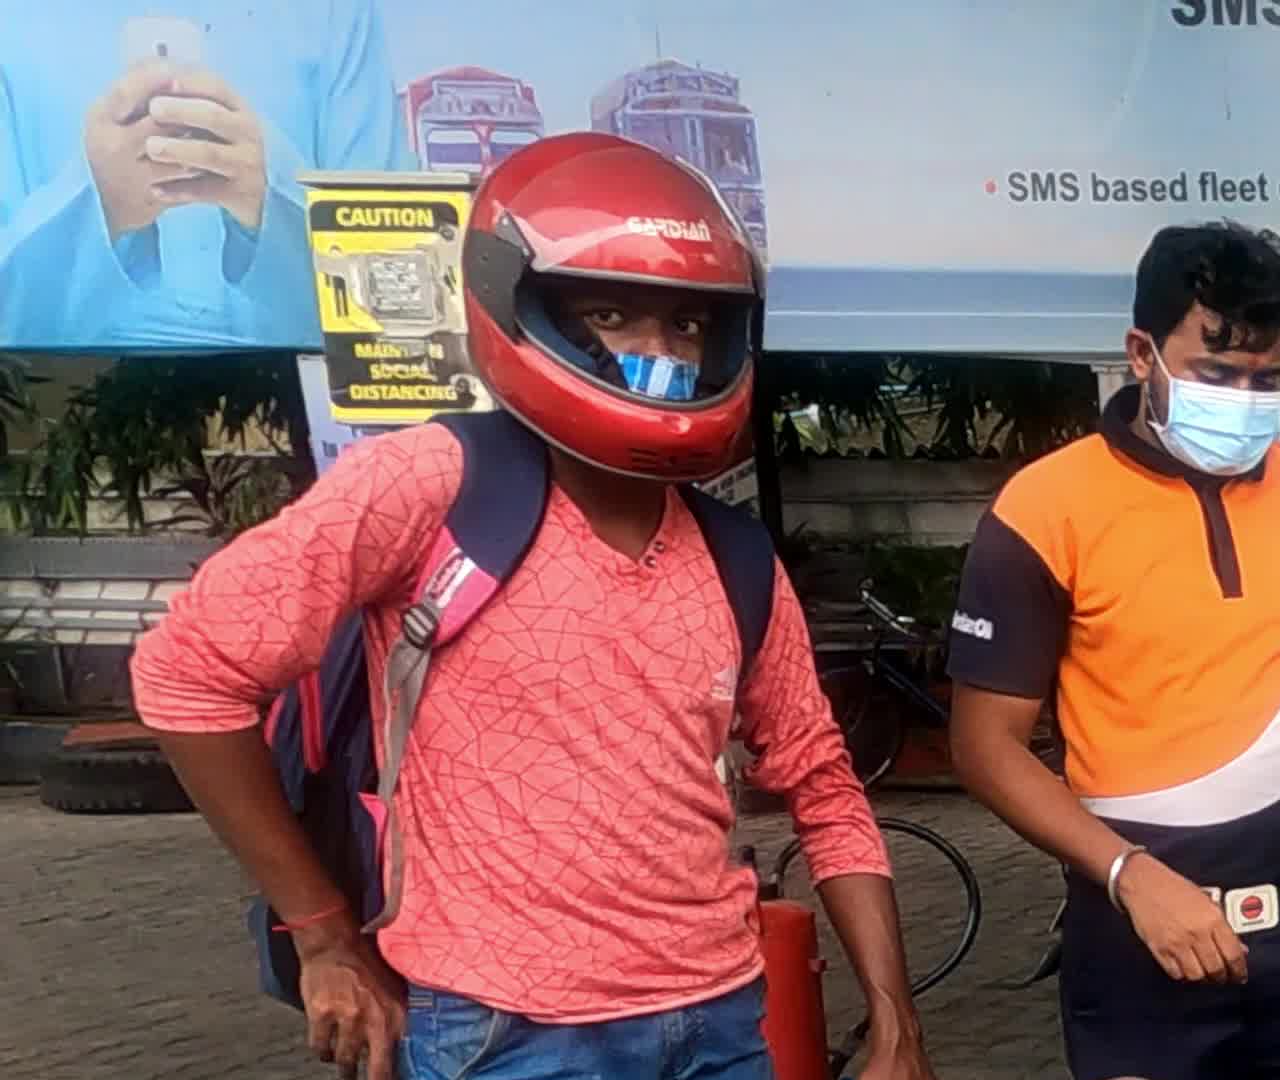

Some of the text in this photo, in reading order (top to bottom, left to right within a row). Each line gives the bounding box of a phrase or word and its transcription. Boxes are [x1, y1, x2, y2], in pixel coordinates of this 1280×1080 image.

[1007, 171, 1081, 202] SMS
[1091, 171, 1188, 202] based
[1198, 171, 1268, 202] fleet
[335, 207, 434, 228] CAUTION
[349, 384, 459, 401] DISTANCING
